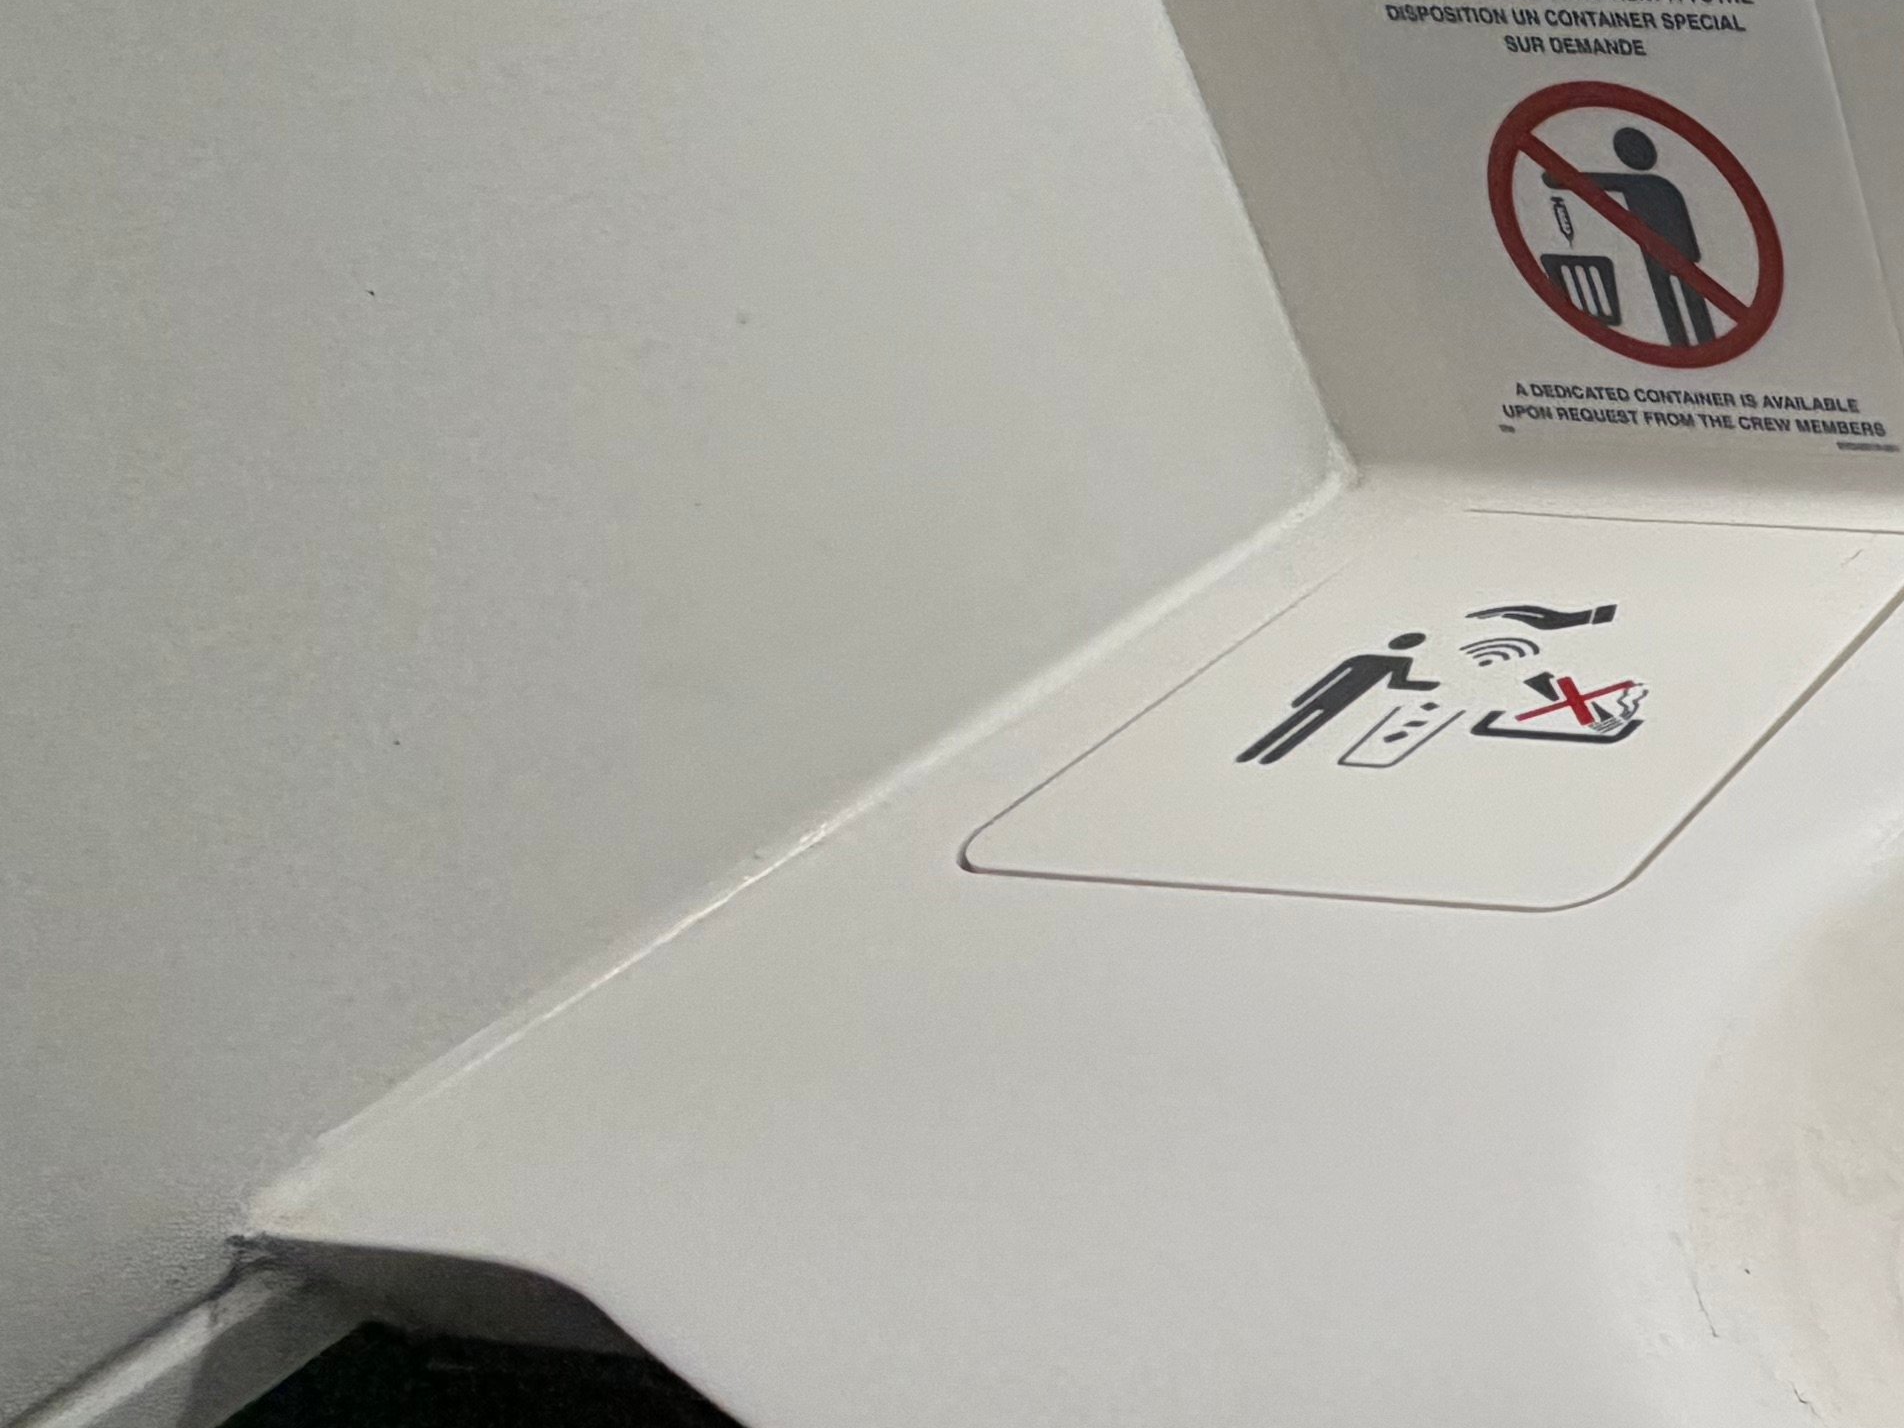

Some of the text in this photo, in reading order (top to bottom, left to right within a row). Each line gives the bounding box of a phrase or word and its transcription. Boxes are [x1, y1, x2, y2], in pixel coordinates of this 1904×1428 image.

[1386, 5, 1746, 32] DISPOSITION UN CONTAINER SPECIAL
[1504, 35, 1647, 56] SUR DEMANDE
[1516, 383, 1860, 413] A DEDICATED CONTAINER IS AVAILABLE
[1503, 405, 1886, 437] UPON REQUEST FROM THE CREW MEMBERS
